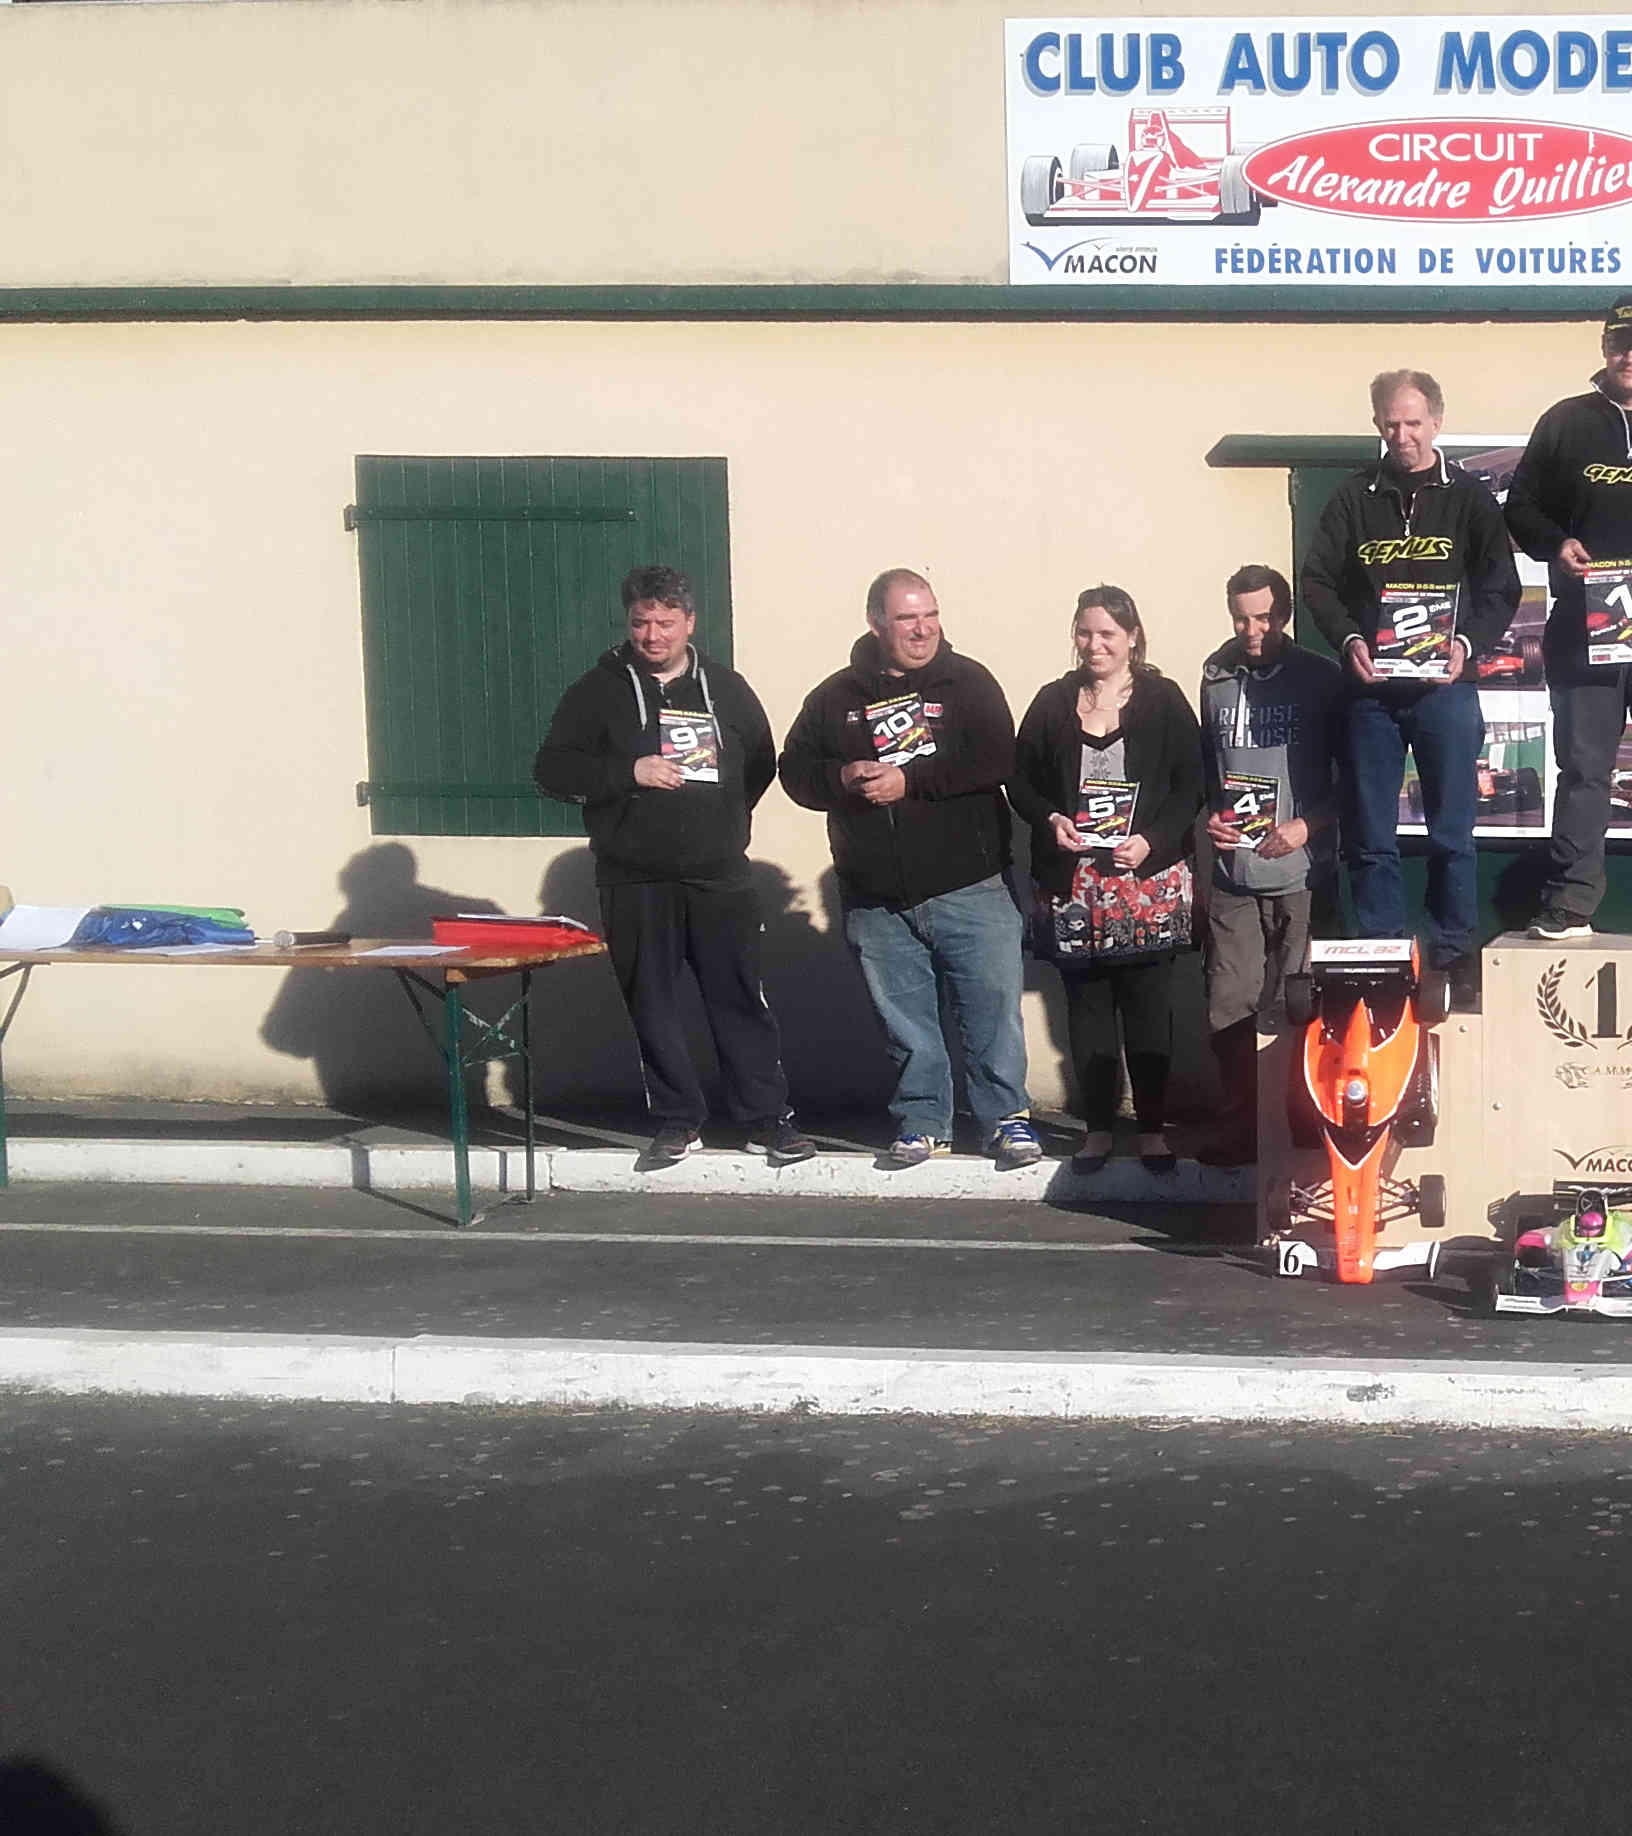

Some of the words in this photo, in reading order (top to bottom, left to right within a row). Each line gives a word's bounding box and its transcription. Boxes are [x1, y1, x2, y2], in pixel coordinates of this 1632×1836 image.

[1023, 31, 1186, 96] CLUB
[1218, 30, 1400, 95] AUTO
[1368, 132, 1543, 162] CIRCUIT
[1267, 154, 1470, 209] Alexandre
[1064, 254, 1157, 273] MACON
[1215, 242, 1396, 275] FÉDÉRATION
[1418, 247, 1454, 274] DE
[1475, 246, 1622, 274] VOITURES
[1393, 604, 1432, 640] 2
[669, 726, 699, 751] 9
[873, 710, 914, 740] 10
[1088, 795, 1116, 819] 5
[1233, 792, 1261, 816] 4
[1585, 961, 1623, 1038] 1
[1283, 1243, 1300, 1274] 6
